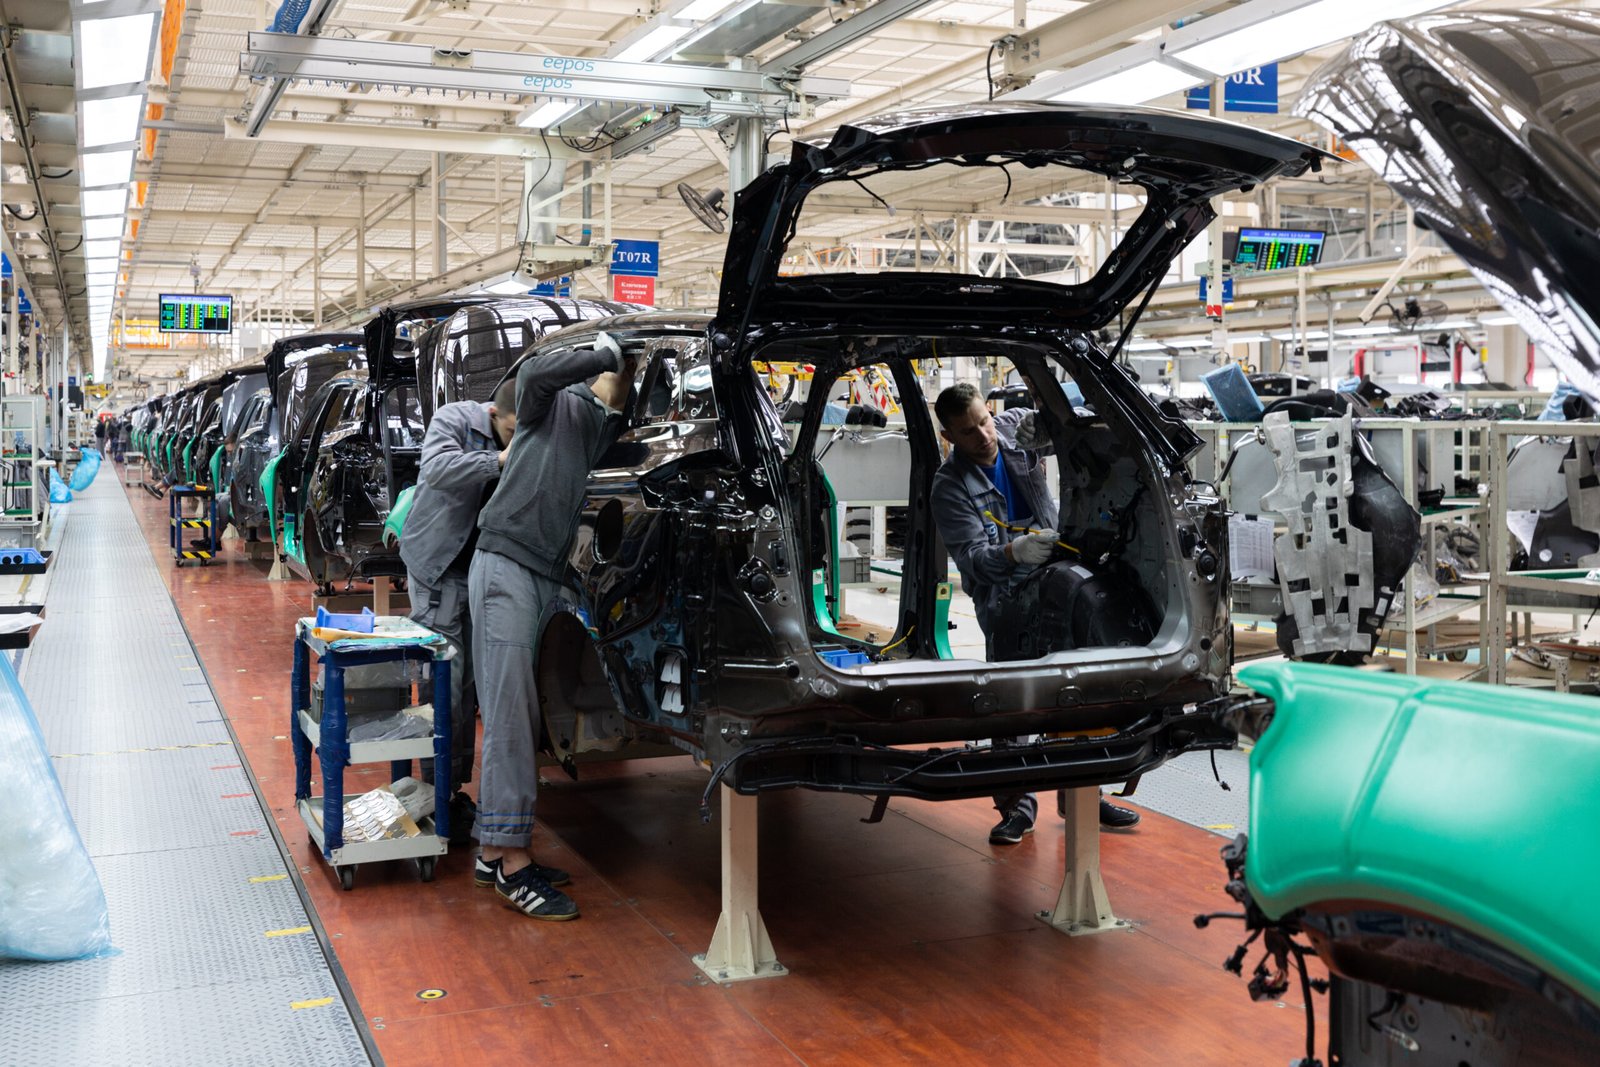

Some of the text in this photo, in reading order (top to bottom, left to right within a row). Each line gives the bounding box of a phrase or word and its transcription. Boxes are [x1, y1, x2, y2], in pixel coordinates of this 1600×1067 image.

[543, 57, 595, 74] eepos
[523, 75, 573, 92] eepos
[617, 251, 651, 264] T07R
[1272, 591, 1282, 606] 4
